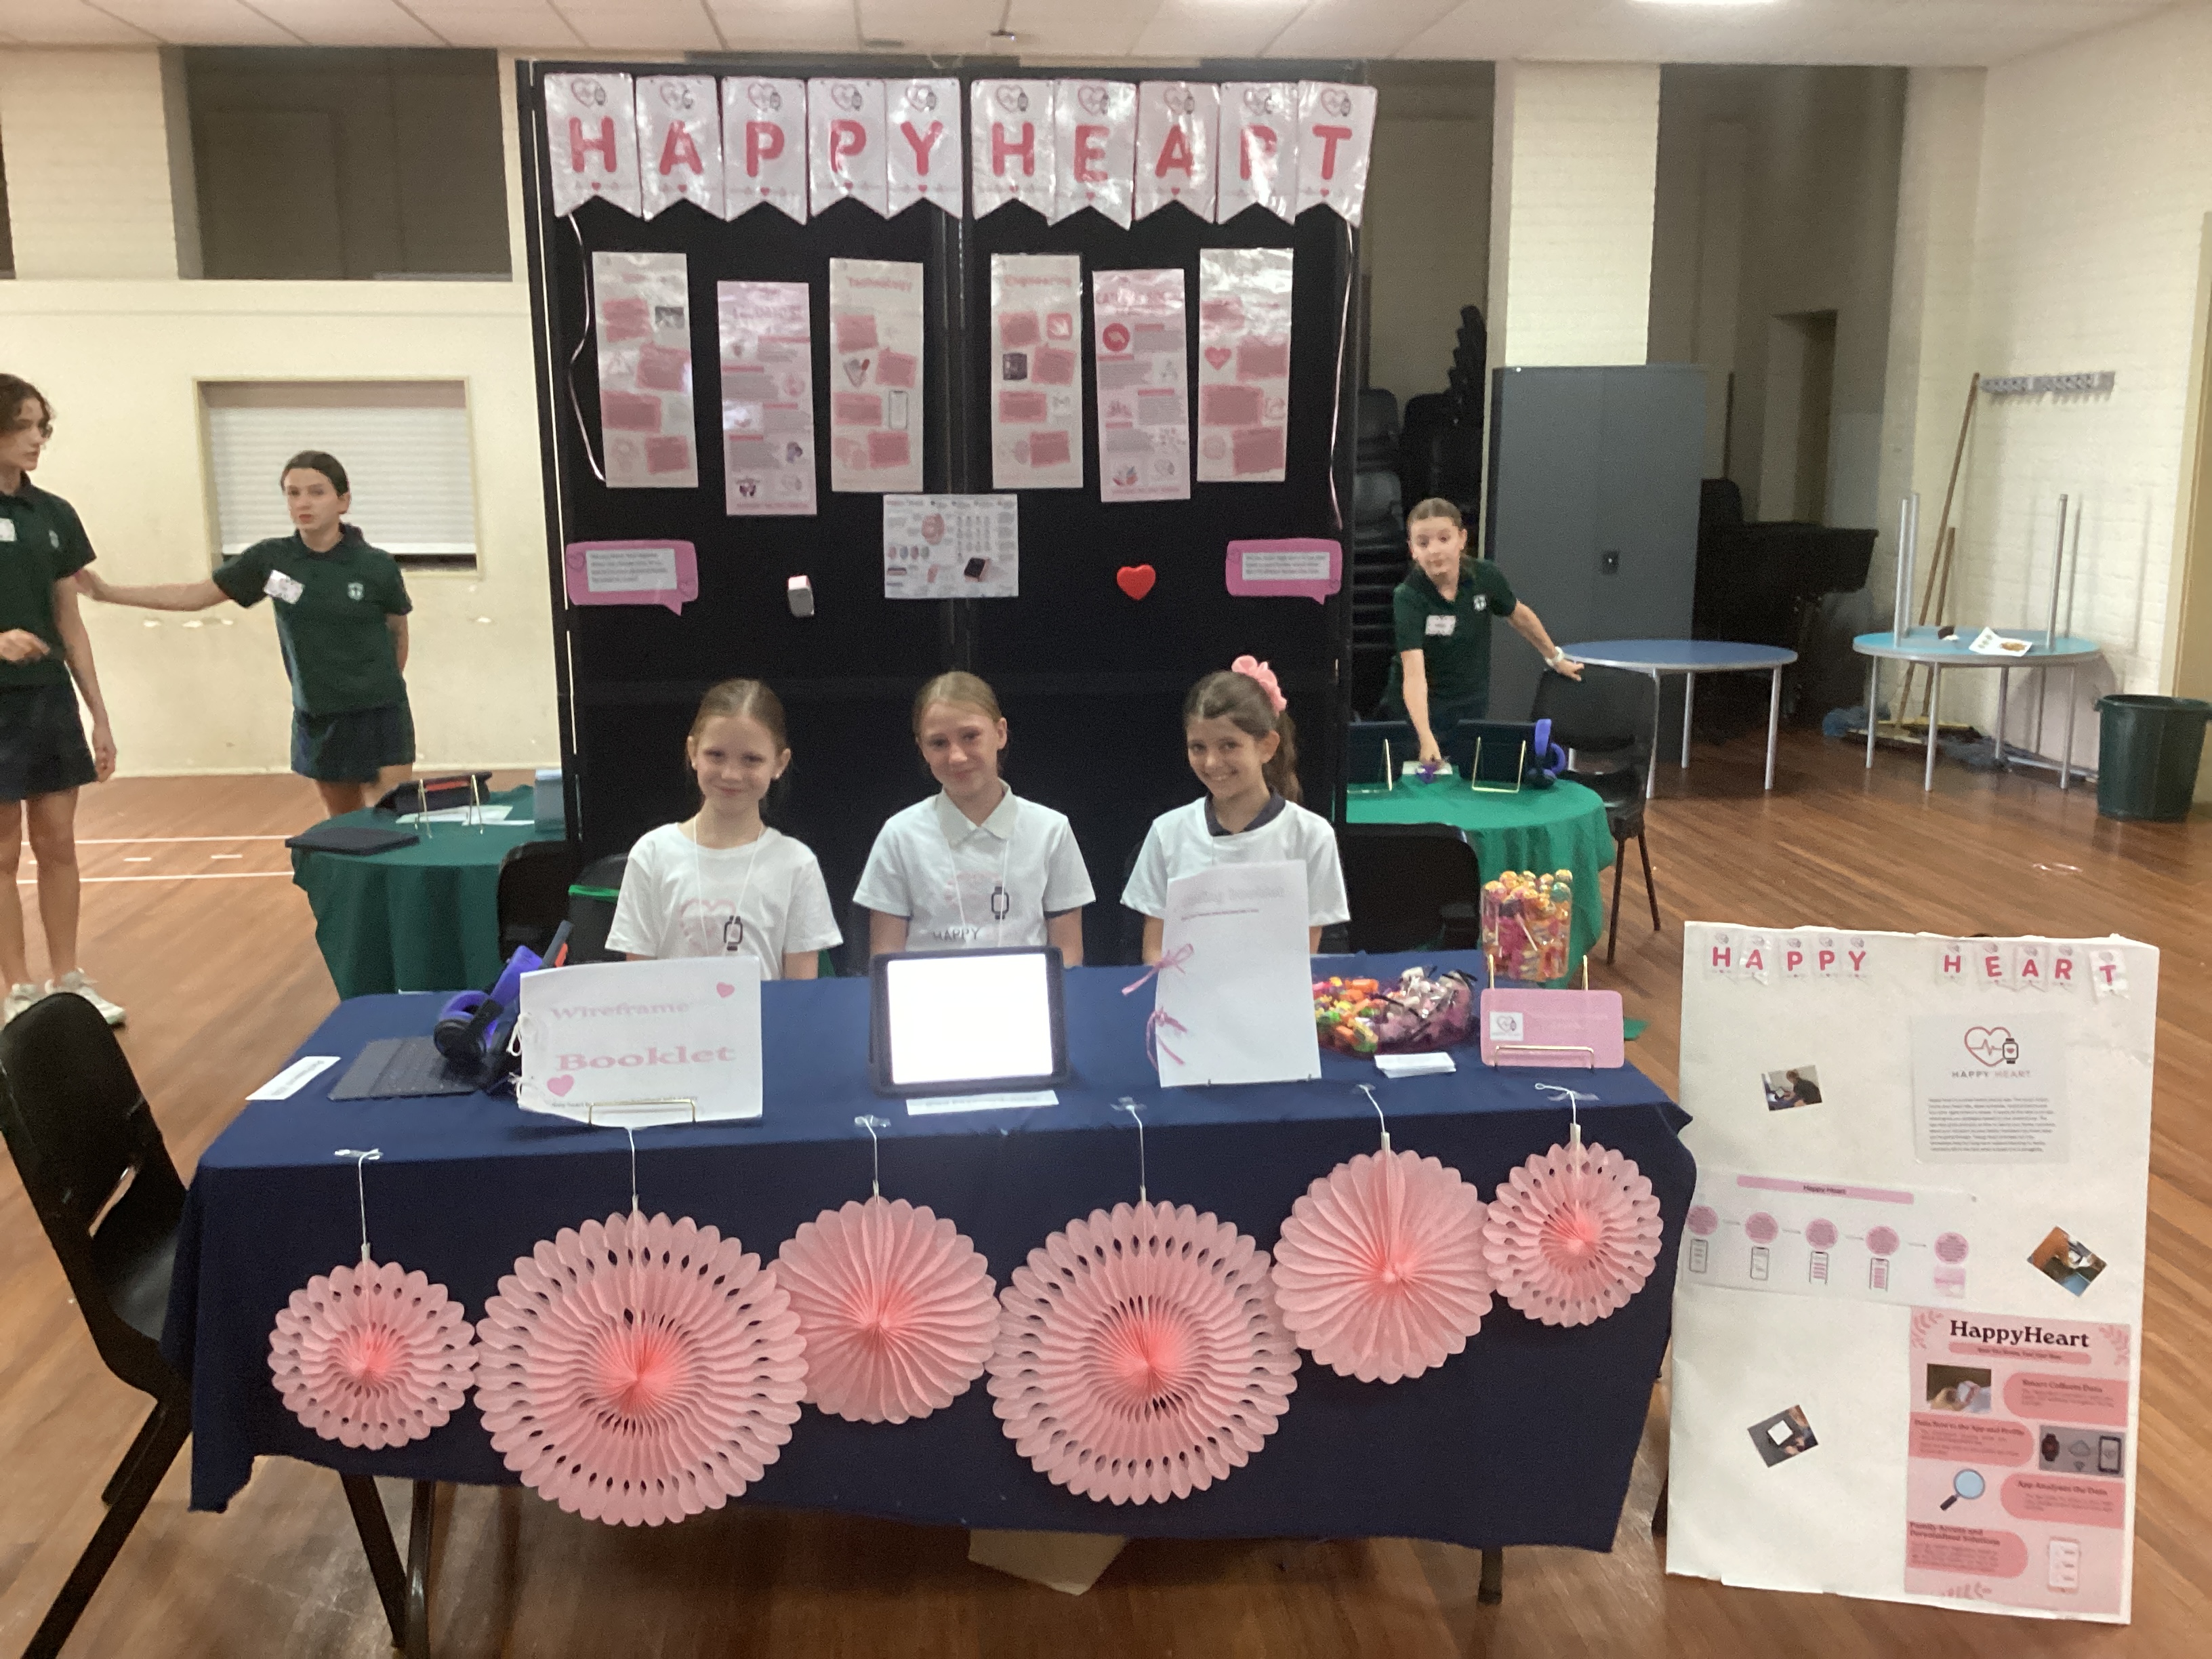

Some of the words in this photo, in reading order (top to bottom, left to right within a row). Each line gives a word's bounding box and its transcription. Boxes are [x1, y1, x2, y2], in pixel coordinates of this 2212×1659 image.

[569, 116, 943, 178] HAPPY
[1712, 946, 1866, 971] HAPPY
[1944, 954, 2116, 986] HEART
[550, 1001, 690, 1021] Wireframe
[556, 1045, 737, 1071] Booklet
[1952, 1070, 1989, 1078] HAPPY
[1950, 1319, 2090, 1348] HappyHeart
